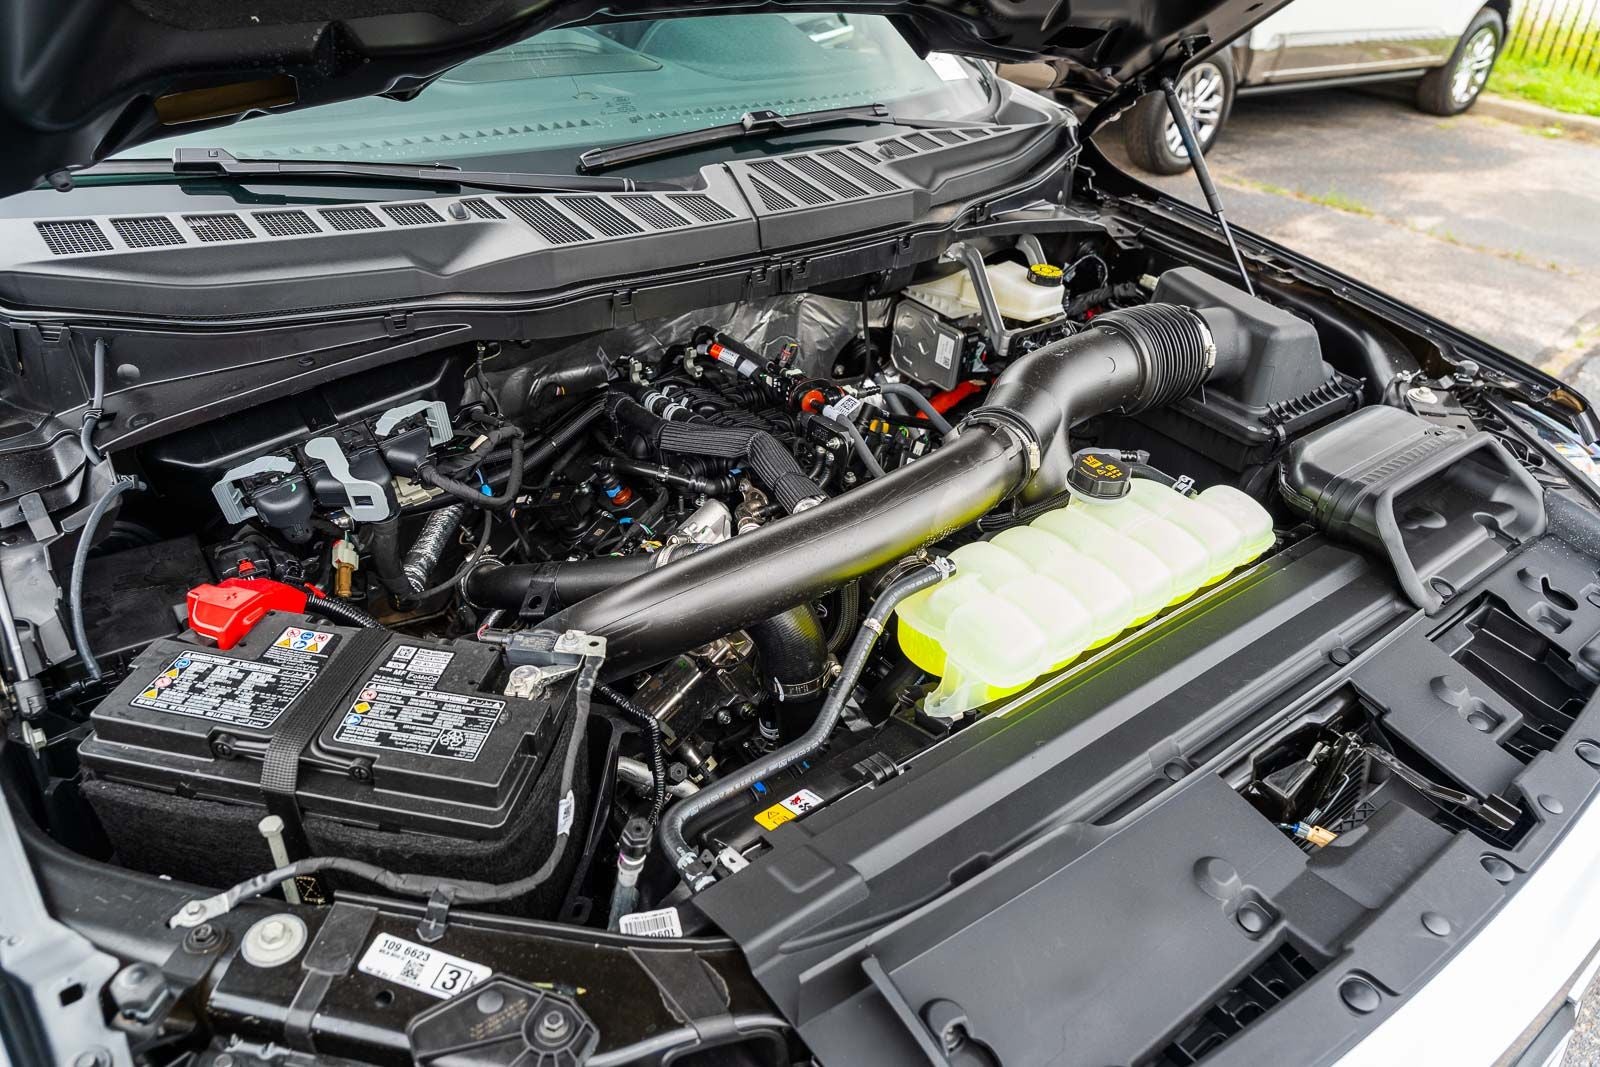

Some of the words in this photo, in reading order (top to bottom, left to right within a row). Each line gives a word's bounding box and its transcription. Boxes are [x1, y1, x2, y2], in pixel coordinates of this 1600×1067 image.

[408, 672, 439, 682] FoMoCo
[384, 940, 402, 951] 109
[404, 946, 431, 961] 6623
[442, 969, 461, 990] 3
